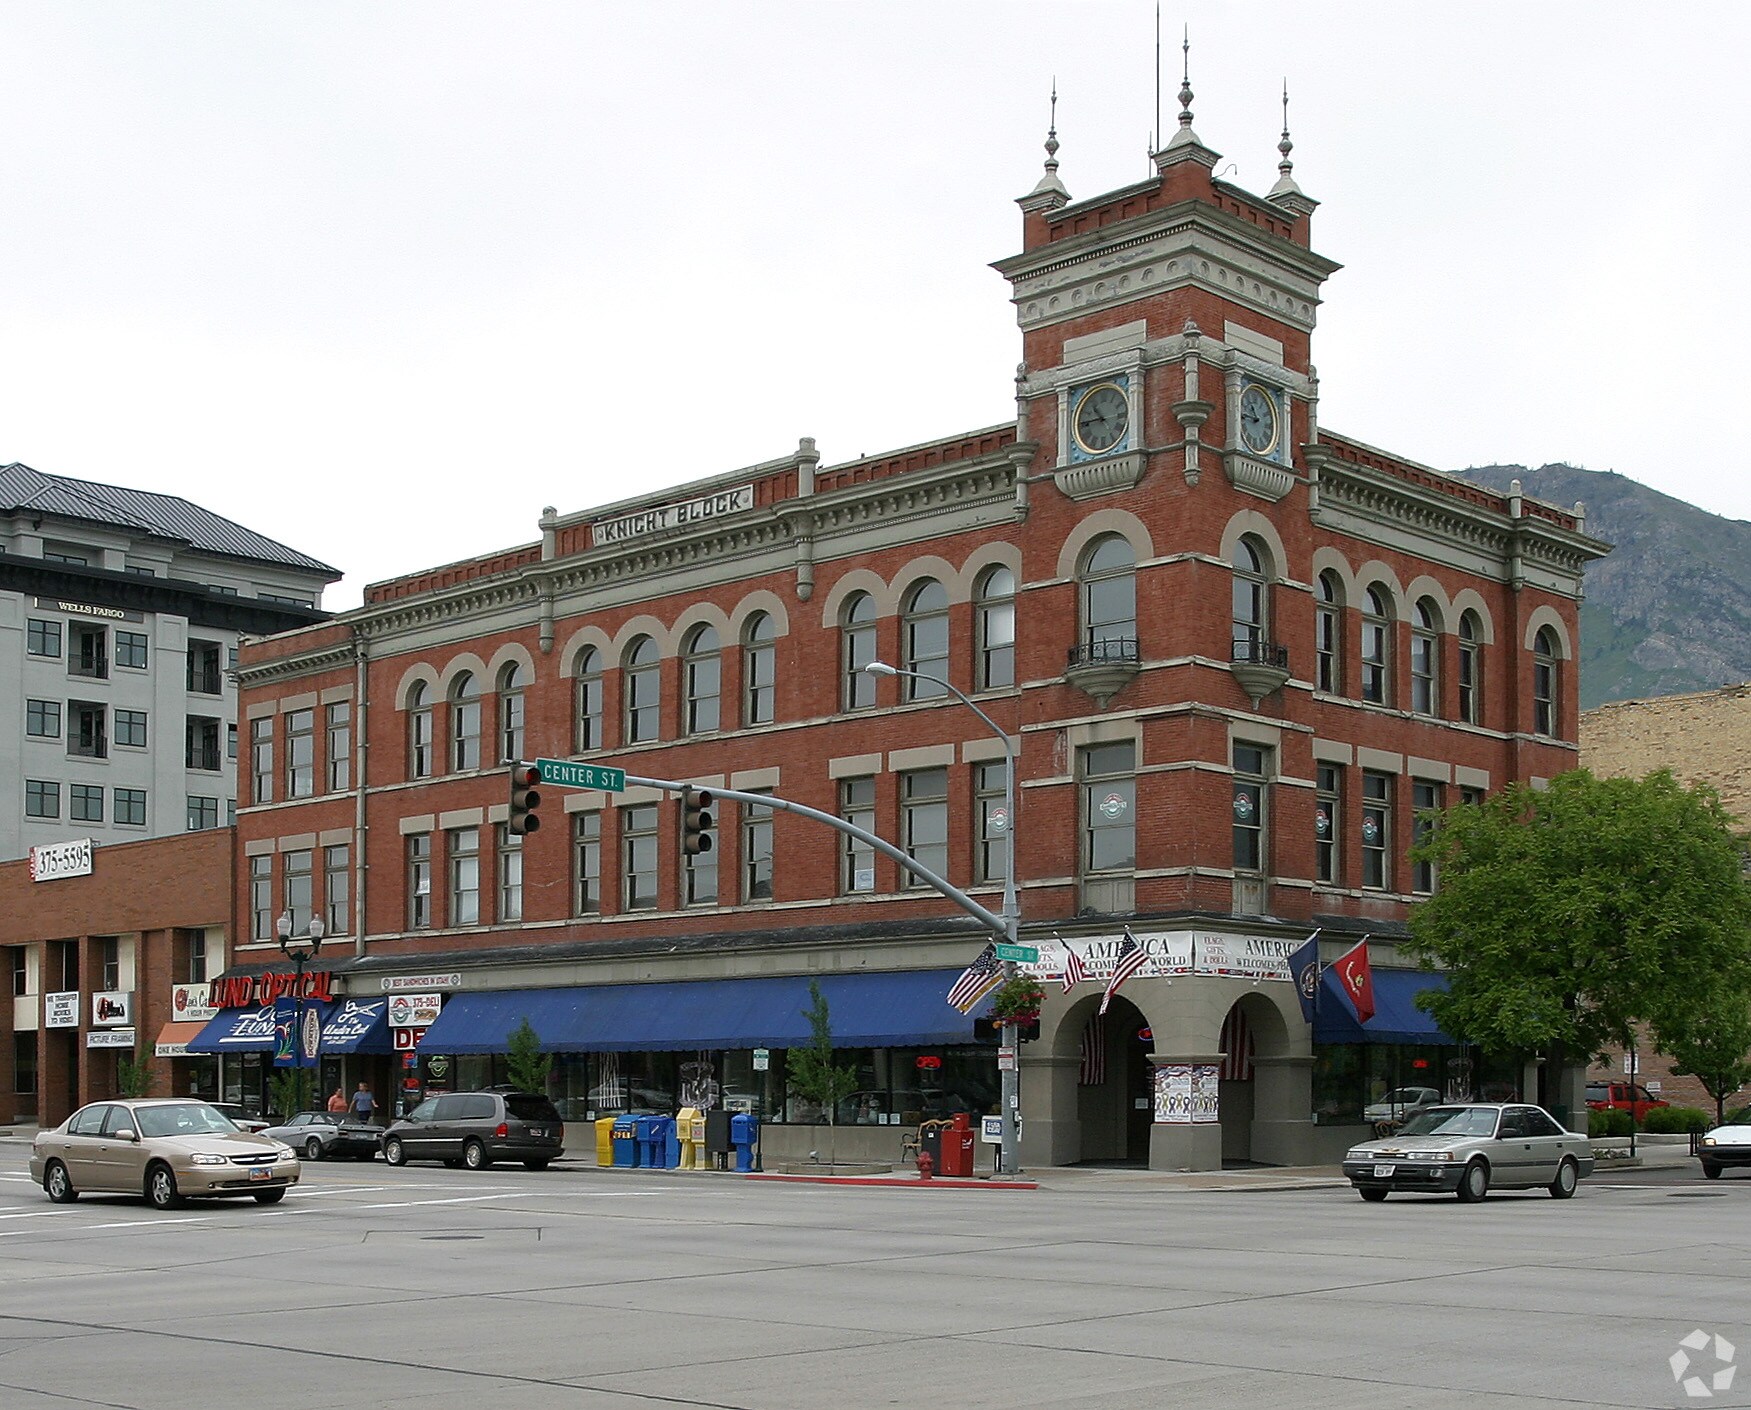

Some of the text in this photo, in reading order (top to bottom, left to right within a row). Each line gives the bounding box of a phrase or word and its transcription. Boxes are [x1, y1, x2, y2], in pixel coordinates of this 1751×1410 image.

[604, 491, 742, 541] KNIGHT BLOCK
[58, 601, 125, 619] WELLS FARGO
[544, 763, 594, 785] CENTER
[39, 845, 90, 874] 375-5595
[1245, 939, 1300, 957] AMERIC
[1033, 963, 1059, 971] DOLLS
[1150, 956, 1186, 967] WORLD
[209, 971, 334, 1008] LUND OPTICAL
